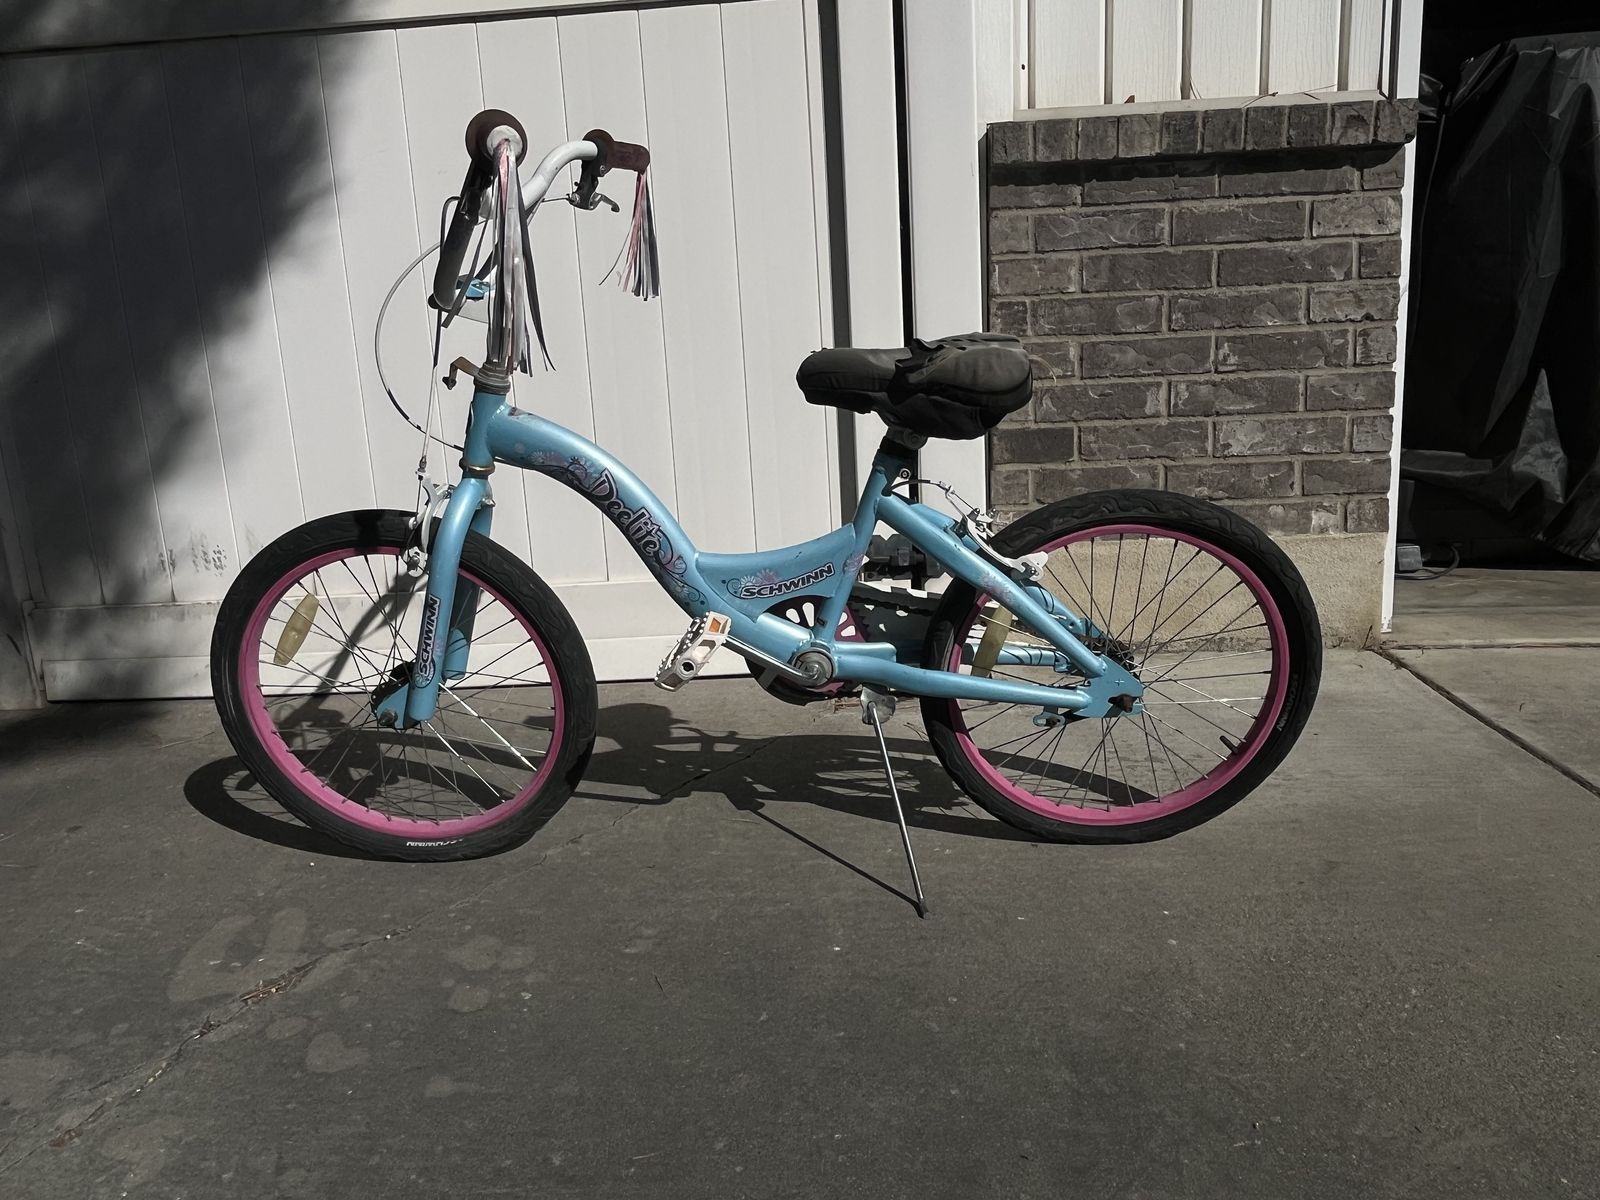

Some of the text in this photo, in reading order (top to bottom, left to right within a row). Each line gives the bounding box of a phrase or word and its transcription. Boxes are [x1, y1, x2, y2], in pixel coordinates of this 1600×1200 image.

[588, 468, 663, 556] Deelite
[742, 563, 834, 598] SCHWINN
[419, 595, 440, 675] SCHWINN
